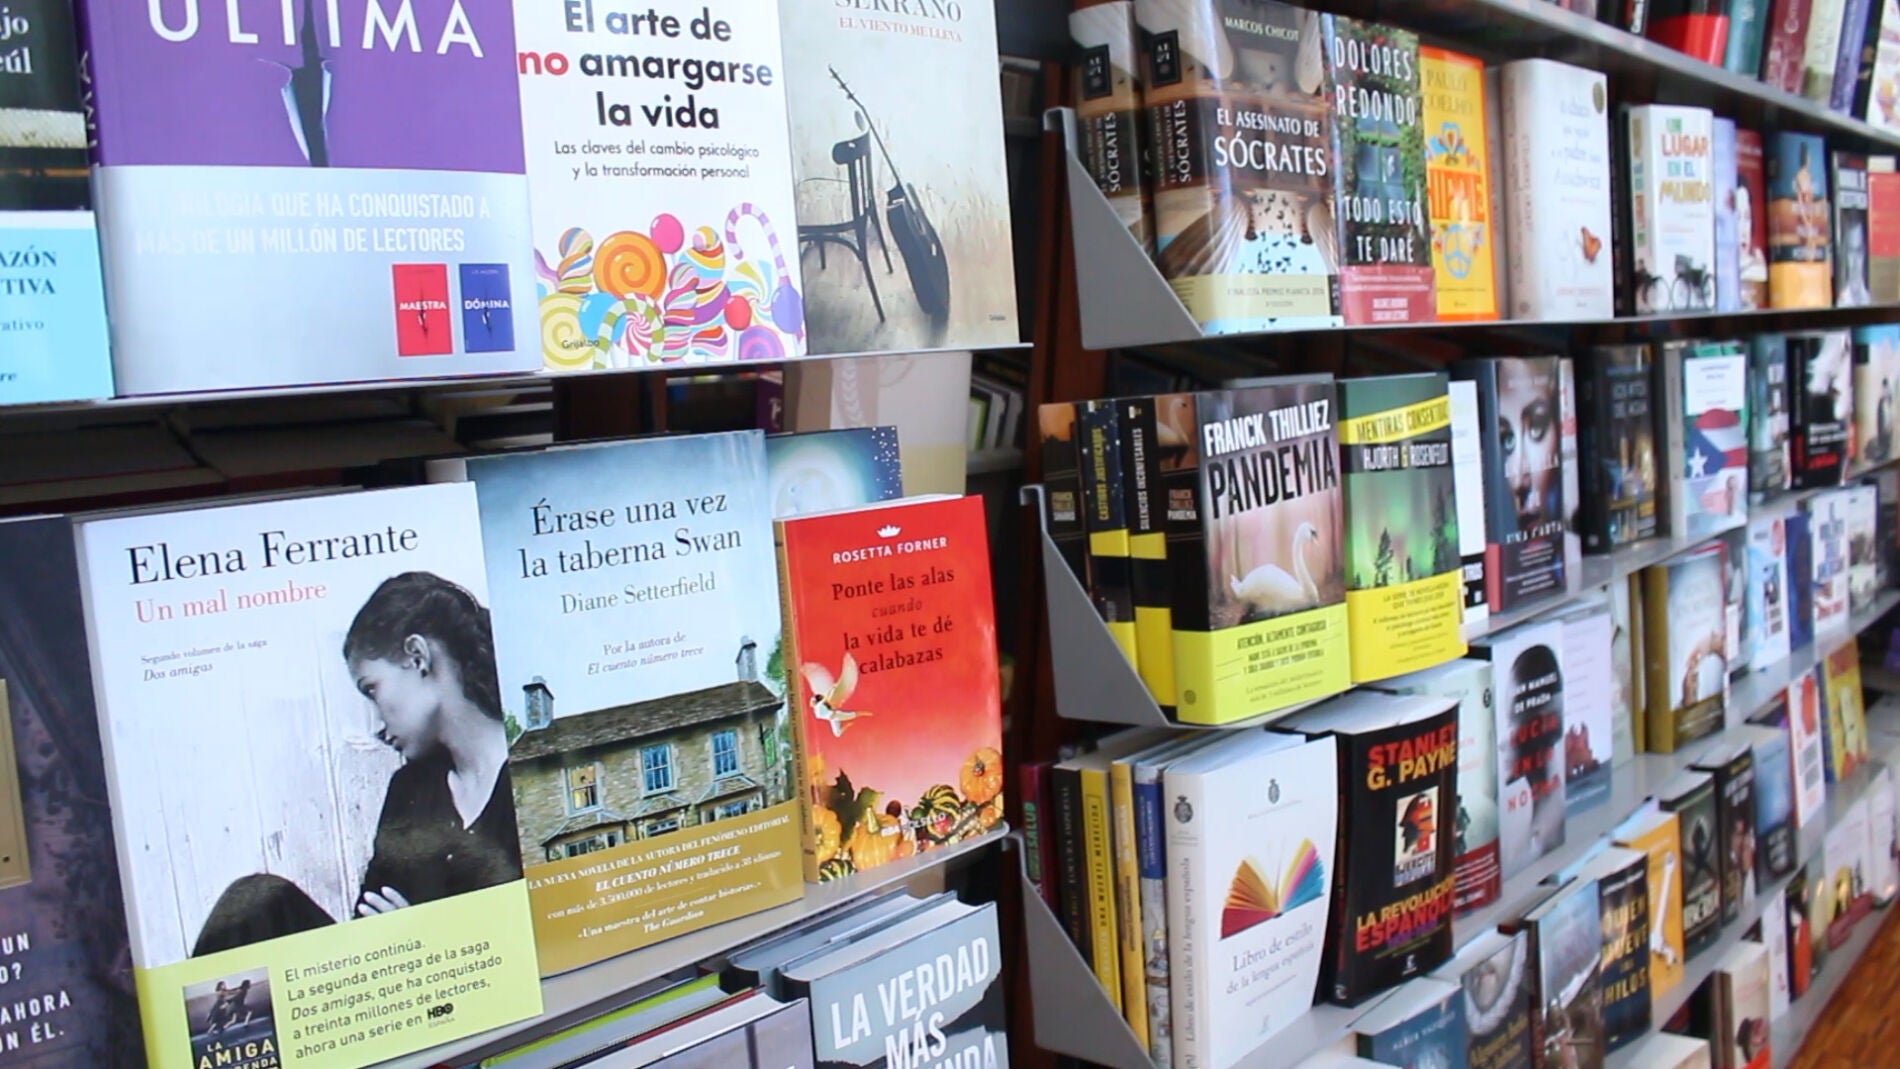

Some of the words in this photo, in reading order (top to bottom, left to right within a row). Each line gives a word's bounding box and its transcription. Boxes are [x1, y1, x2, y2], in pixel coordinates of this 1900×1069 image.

[564, 0, 594, 33] El
[606, 9, 680, 37] arte
[690, 7, 732, 41] de
[1225, 16, 1263, 34] MARCOS
[1265, 24, 1299, 41] CHICOT
[518, 51, 569, 76] no
[580, 54, 773, 90] amargarse
[1334, 38, 1413, 81] DOLORES
[596, 91, 632, 126] la
[641, 94, 719, 129] vida
[1216, 107, 1232, 126] EL
[1236, 111, 1301, 136] ASESINATO
[1303, 120, 1320, 137] DE
[1336, 84, 1416, 126] REDONDO
[554, 141, 577, 155] Las
[581, 141, 622, 155] claves
[626, 140, 646, 155] del
[650, 141, 695, 156] cambio
[699, 143, 760, 161] psicológico
[1104, 112, 1121, 192] SÓCRATES
[1173, 99, 1192, 183] SÓCRATES
[1214, 131, 1327, 176] SÓCRATES
[1660, 133, 1709, 158] LUGAR
[572, 166, 580, 181] y
[585, 162, 598, 177] la
[602, 163, 697, 178] transformación
[701, 166, 750, 180] personal
[316, 192, 344, 218] HA
[350, 193, 475, 219] CONQUISTADO
[1344, 196, 1382, 224] TODO
[1388, 199, 1423, 227] ESTO
[262, 223, 337, 254] MILLÓN
[343, 228, 367, 252] DE
[373, 227, 465, 253] LECTORES
[1356, 235, 1373, 257] TE
[1380, 234, 1414, 263] DARÉ
[399, 300, 448, 311] MAESTRA
[1203, 413, 1266, 458] FRANCK
[1268, 399, 1332, 442] THILLIEZ
[1207, 436, 1338, 520] PANDEMIA
[530, 497, 616, 536] Érase
[625, 500, 677, 524] una
[686, 493, 729, 517] vez
[1137, 490, 1150, 531] SILENCIOS
[125, 542, 247, 585] Elena
[258, 526, 419, 568] Ferrante
[517, 548, 548, 579] la
[558, 540, 667, 573] taberna
[673, 527, 742, 557] Swan
[832, 545, 892, 565] ROSETTA
[897, 537, 948, 554] FORNER
[135, 599, 173, 624] Un
[182, 588, 228, 617] mal
[236, 579, 327, 610] nombre
[560, 591, 619, 614] Diane
[623, 571, 717, 605] Setterfield
[832, 580, 884, 600] Ponte
[890, 573, 915, 592] las
[921, 566, 955, 586] alas
[871, 598, 924, 618] cuando
[603, 643, 622, 656] Por
[624, 640, 636, 653] la
[637, 636, 671, 650] autora
[673, 632, 687, 644] de
[843, 632, 860, 650] la
[866, 624, 905, 646] vida
[910, 623, 927, 638] te
[933, 615, 954, 633] dé
[143, 668, 166, 682] Dos
[168, 662, 214, 680] amigas
[587, 662, 600, 676] El
[602, 658, 638, 673] cuento
[639, 650, 679, 666] número
[680, 645, 705, 658] trece
[858, 647, 944, 675] calabazas
[1367, 764, 1392, 792] G.
[1399, 741, 1458, 783] PAYNE
[594, 880, 611, 892] EL
[611, 867, 658, 888] CUENTO
[659, 853, 706, 876] NÚMERO
[707, 843, 742, 862] TRECE
[1356, 911, 1377, 931] LA
[284, 968, 300, 983] El
[303, 955, 362, 978] misterio
[364, 938, 426, 963] continúa.
[287, 986, 306, 1002] La
[309, 973, 368, 996] segunda
[371, 959, 423, 981] entrega
[425, 953, 442, 966] de
[444, 949, 457, 961] la
[460, 940, 491, 958] saga
[1232, 945, 1267, 973] Libro
[1271, 937, 1284, 953] de
[291, 1005, 318, 1021] Dos
[321, 990, 376, 1014] amigas,
[378, 981, 404, 999] que
[406, 974, 423, 989] ha
[425, 955, 503, 985] conquistado
[831, 992, 872, 1050] LA
[877, 936, 990, 1028] VERDAD
[1226, 979, 1240, 996] de
[1241, 975, 1251, 989] la
[1251, 957, 1281, 983] lengua
[1604, 966, 1648, 1005] HILOS
[1, 990, 73, 1024] AHORA
[293, 1028, 302, 1040] a
[305, 1015, 352, 1037] treinta
[355, 998, 414, 1023] millones
[416, 992, 433, 1006] de
[435, 977, 492, 1001] lectores,
[31, 1022, 66, 1047] ÉL.
[207, 1041, 223, 1053] LA
[295, 1038, 337, 1060] ahora
[339, 1030, 366, 1047] una
[368, 1020, 404, 1039] serie
[406, 1014, 423, 1028] en
[427, 1002, 455, 1020] HBO
[884, 1005, 948, 1069] MÁS
[199, 1038, 275, 1069] AMIGA
